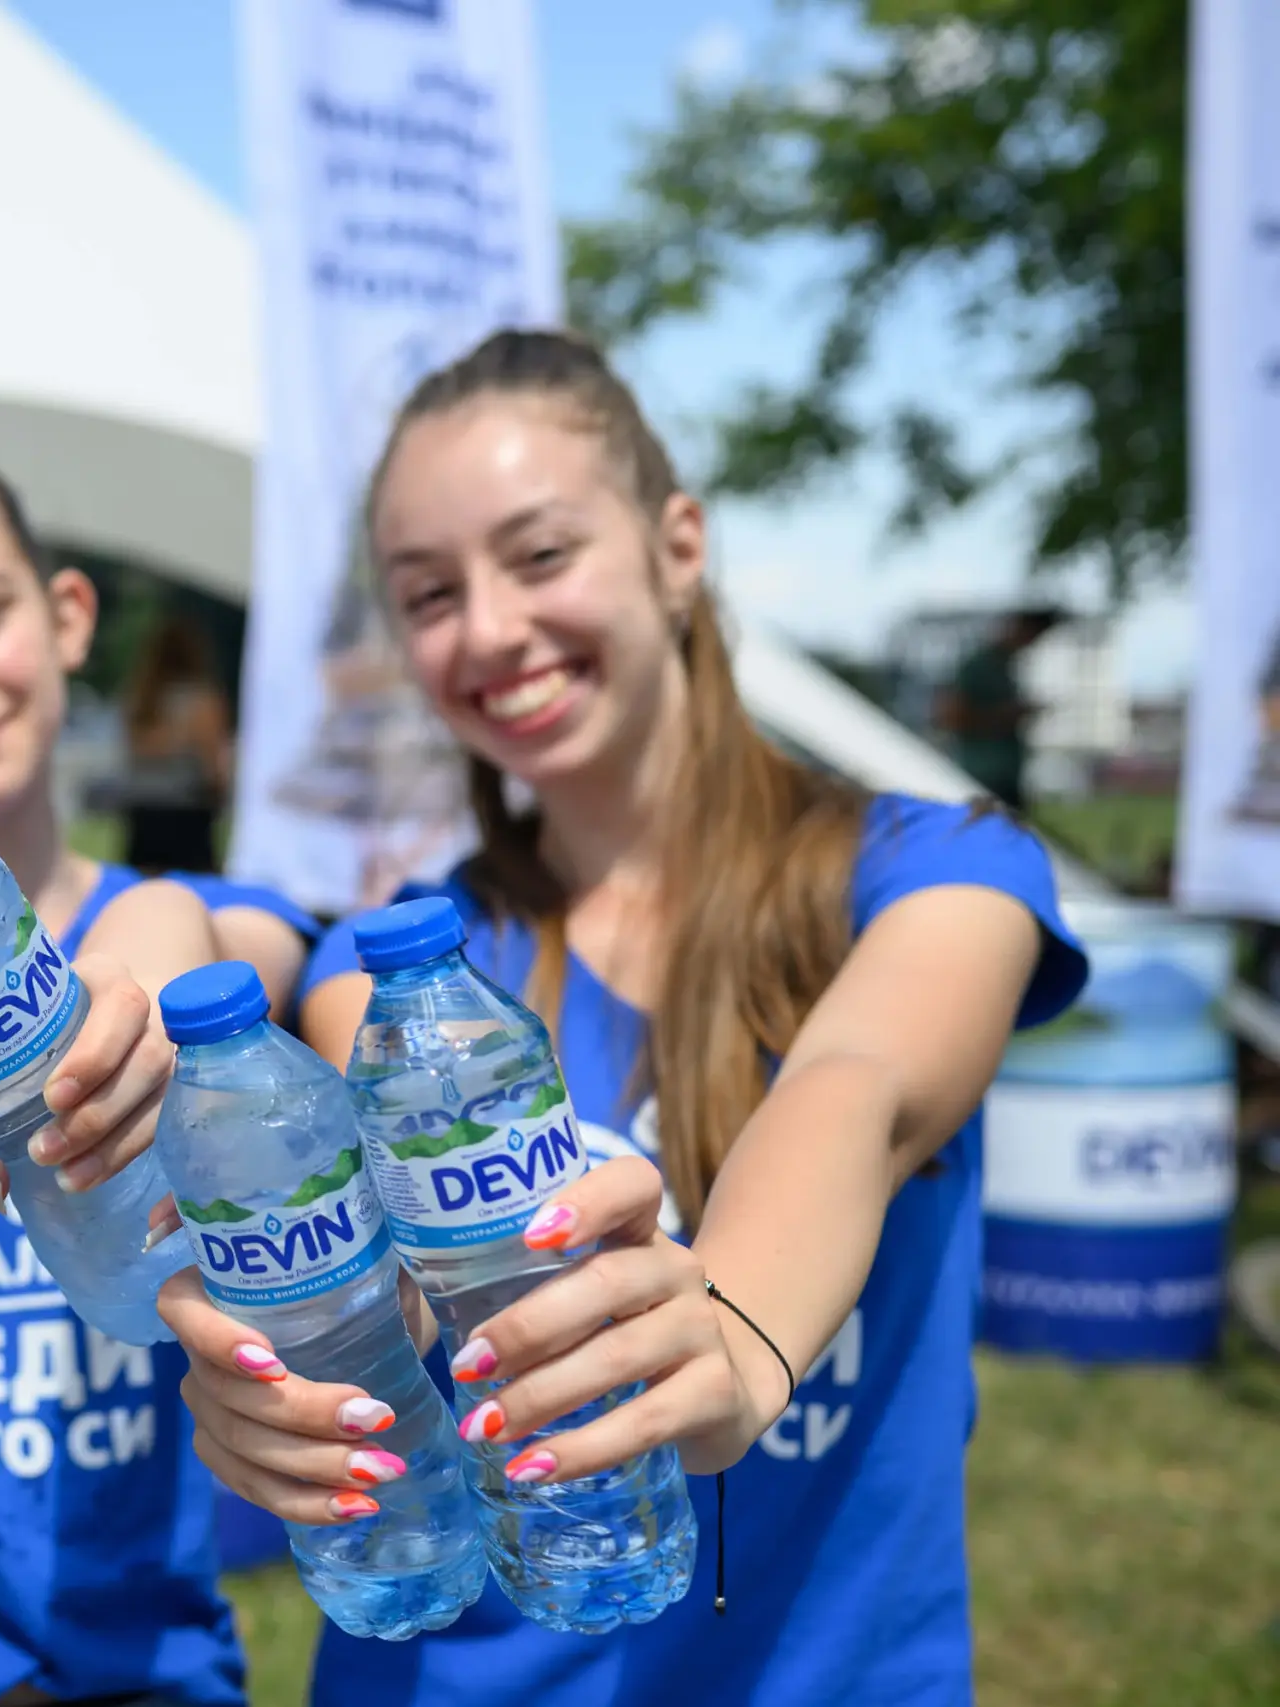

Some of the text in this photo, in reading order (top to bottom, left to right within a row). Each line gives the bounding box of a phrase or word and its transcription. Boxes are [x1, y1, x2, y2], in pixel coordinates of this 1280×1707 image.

[8, 974, 18, 987] 9
[33, 1006, 69, 1050] МИНЕРАЛНА
[430, 1115, 578, 1212] DEVIN
[200, 1200, 355, 1274] DEVIN
[267, 1221, 277, 1232] 9
[452, 1220, 514, 1242] НАТУРАЛНА
[220, 1261, 362, 1301] НАТУРАЛНА МИНЕРАЛНА ВОДА
[66, 1404, 157, 1471] СИ
